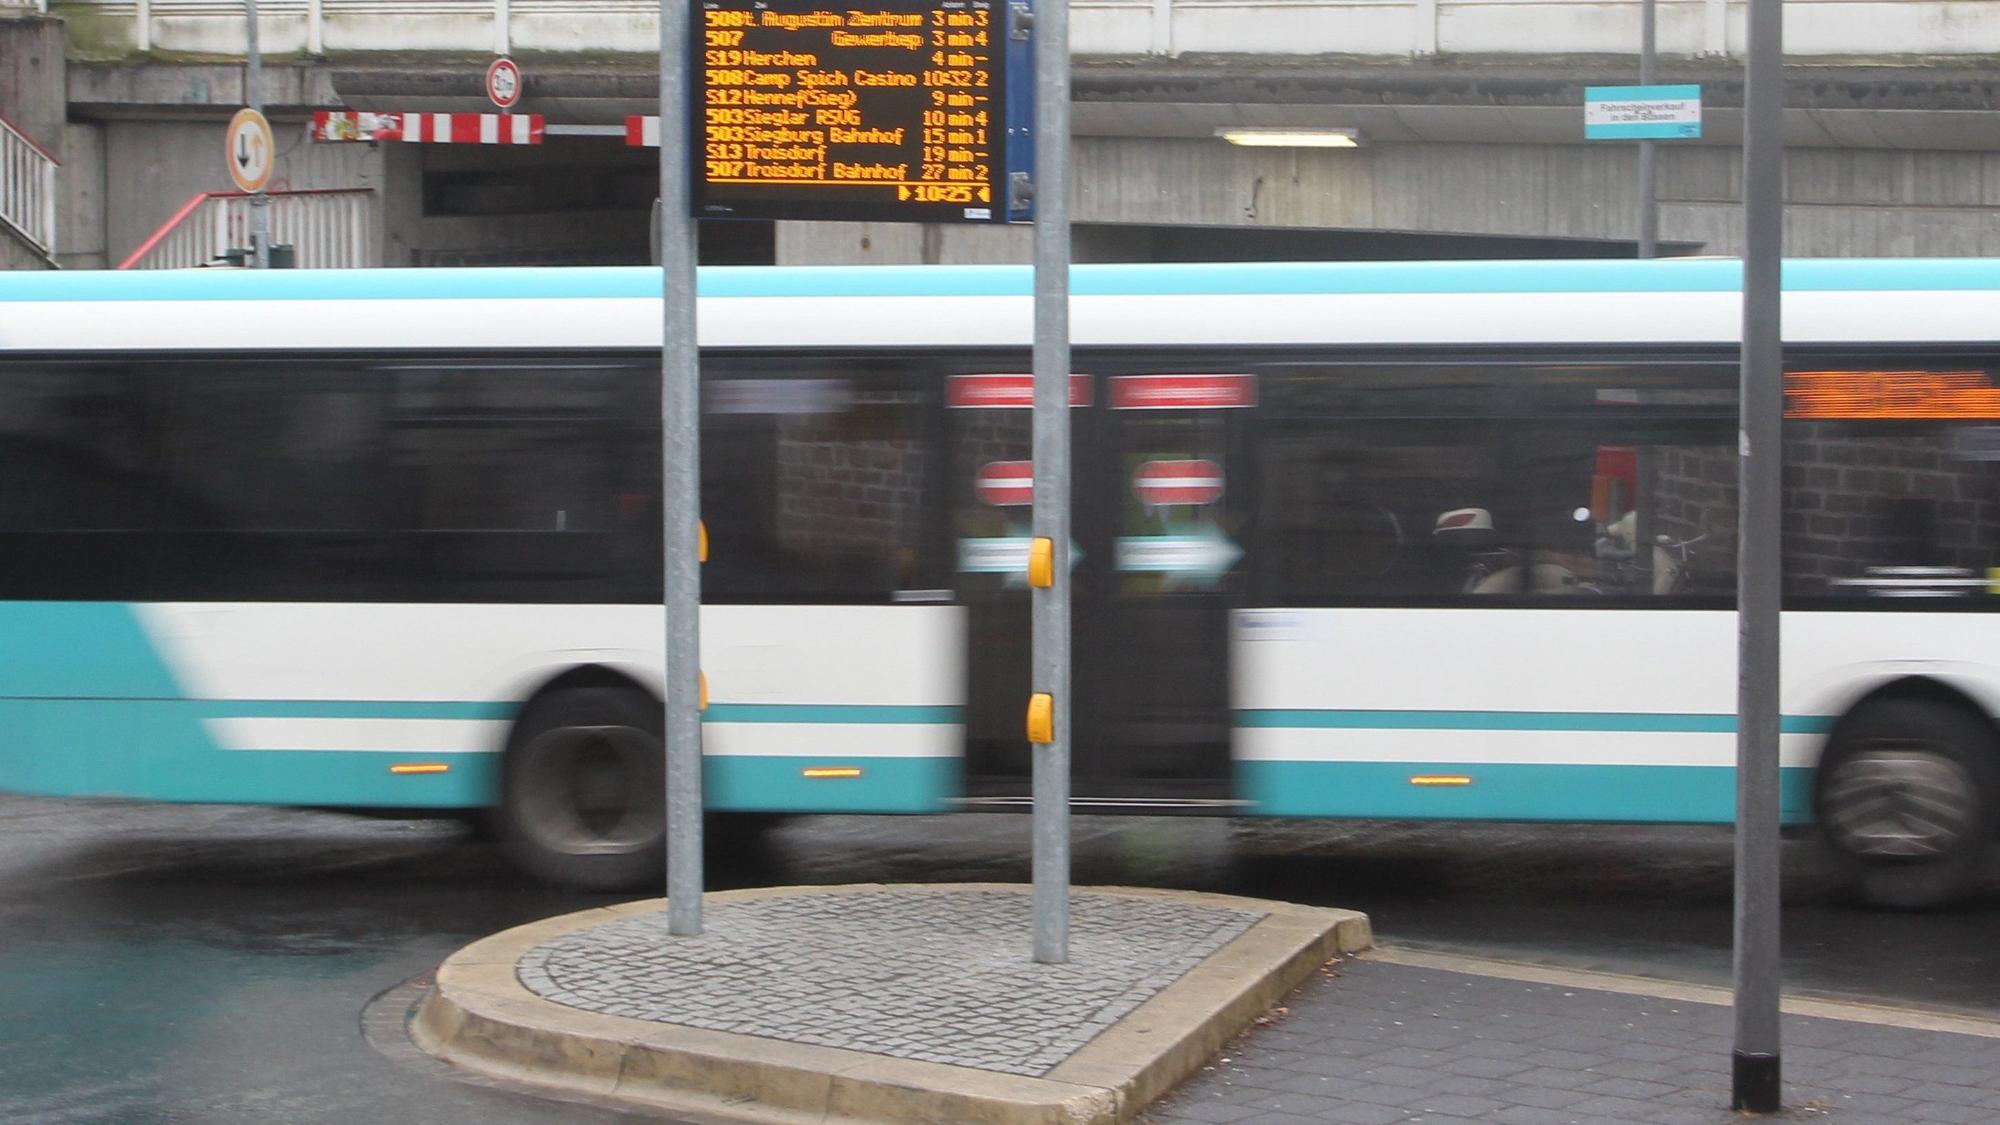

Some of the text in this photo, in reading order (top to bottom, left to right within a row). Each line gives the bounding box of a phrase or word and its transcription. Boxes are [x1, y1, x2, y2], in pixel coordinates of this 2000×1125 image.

[705, 10, 742, 27] 508
[761, 10, 845, 31] Augustin
[846, 10, 924, 27] Zentrum
[932, 10, 945, 27] 3
[947, 10, 975, 27] min
[975, 10, 989, 27] 3
[705, 30, 744, 46] 507
[932, 30, 945, 47] 3
[947, 30, 975, 47] min
[975, 30, 989, 47] 4
[705, 50, 742, 66] S19
[743, 50, 817, 66] Herchen
[932, 50, 945, 67] 4
[947, 50, 975, 67] min
[705, 69, 742, 85] 508
[743, 69, 791, 89] Camp
[797, 69, 849, 89] Spich
[854, 69, 918, 87] Casino
[975, 70, 989, 87] 2
[705, 89, 742, 105] S12
[743, 89, 857, 109] Hennef(Sieg)
[931, 90, 945, 106] 9
[947, 90, 975, 107] min
[705, 108, 743, 124] 503
[743, 108, 810, 127] Sieglar
[923, 110, 945, 126] 10
[947, 110, 975, 127] min
[975, 110, 989, 127] 4
[705, 126, 987, 145] 503 Siegburg Bahnhof 15 min 1
[706, 143, 743, 159] S13
[744, 143, 828, 162] Troisdorf
[923, 146, 945, 162] 19
[947, 146, 975, 162] min
[706, 161, 989, 181] 507 Troisdorf Bahnhof 27 min 2
[914, 185, 973, 203] 10:25
